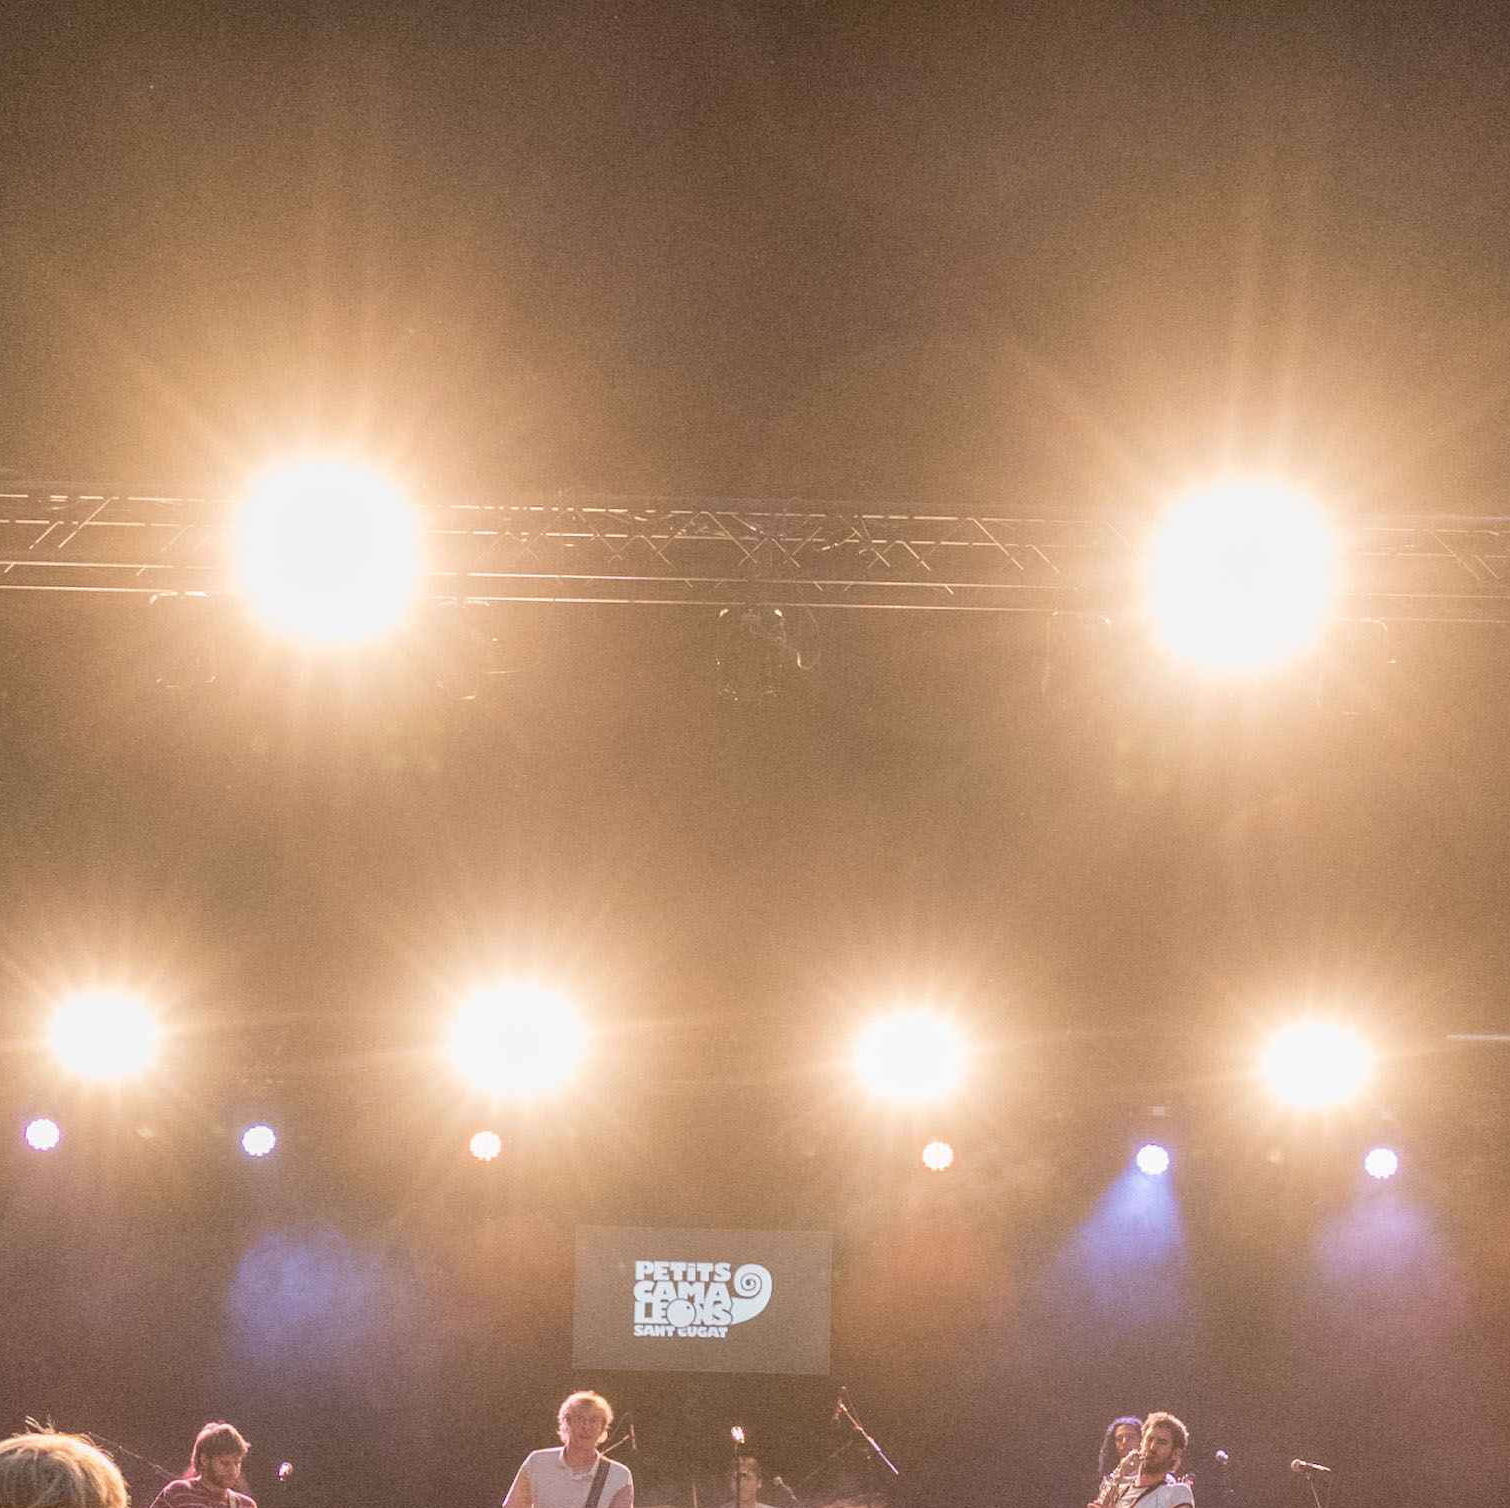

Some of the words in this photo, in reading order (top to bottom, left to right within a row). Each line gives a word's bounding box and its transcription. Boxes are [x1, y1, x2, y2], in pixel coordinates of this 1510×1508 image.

[633, 1280, 733, 1306] CAMA
[633, 1324, 676, 1338] SANT
[677, 1325, 729, 1339] CUGAT
